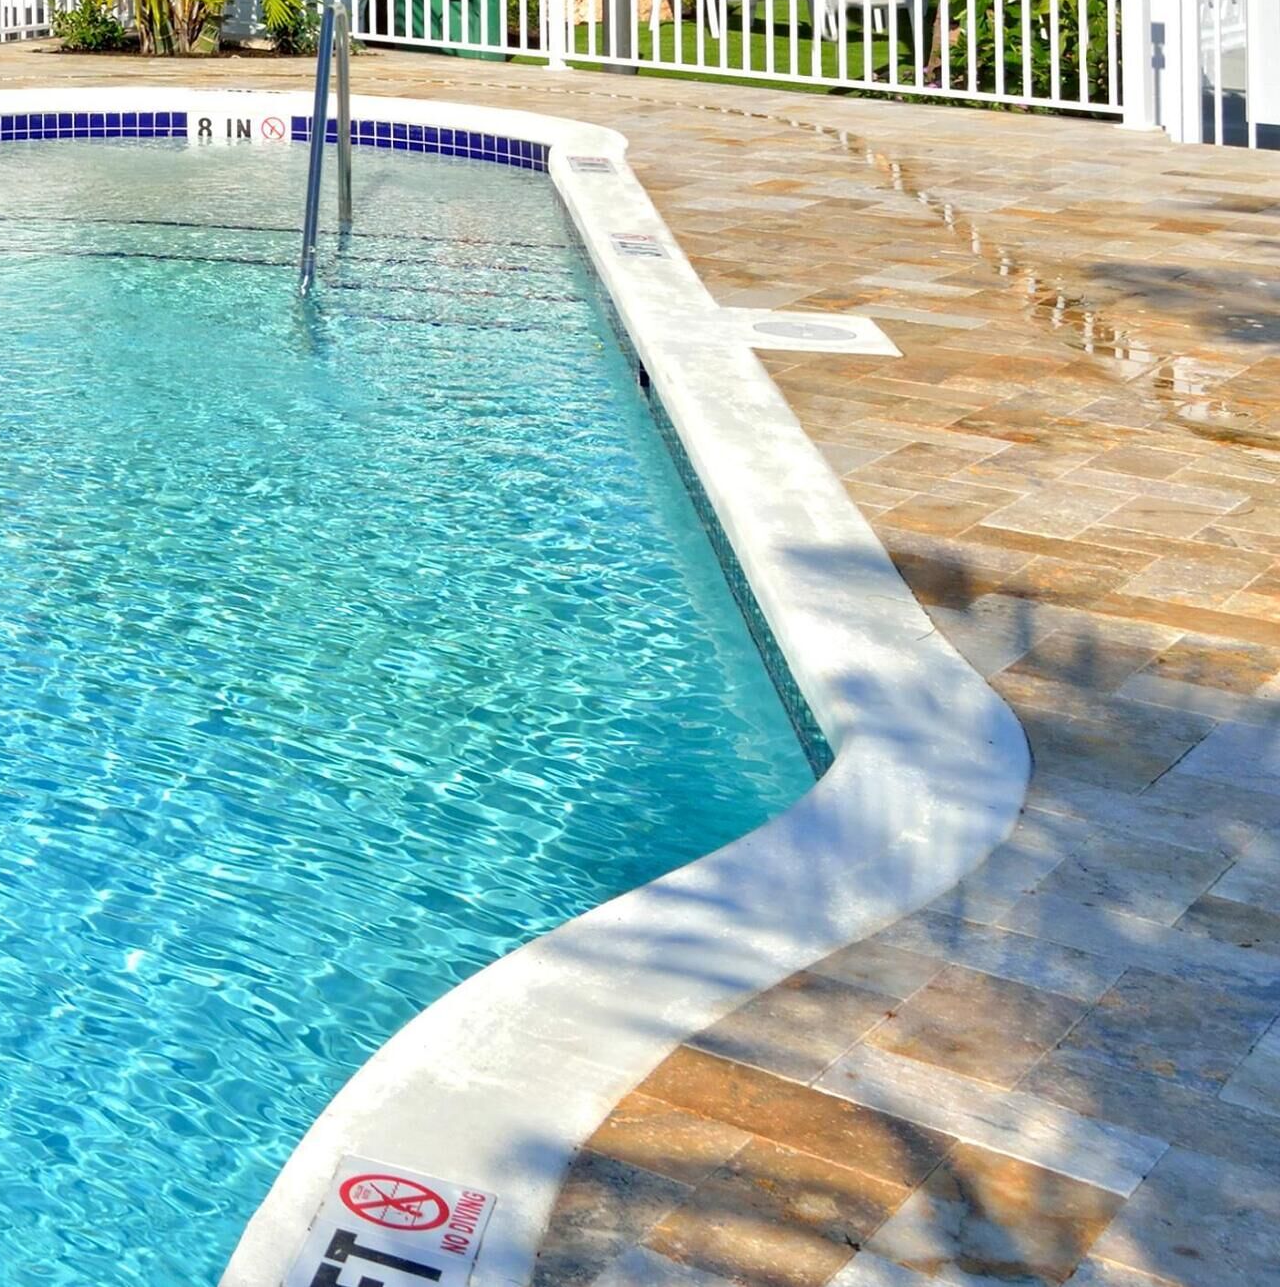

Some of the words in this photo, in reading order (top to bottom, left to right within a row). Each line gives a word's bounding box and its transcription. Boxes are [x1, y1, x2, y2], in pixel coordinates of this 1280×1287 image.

[198, 117, 213, 138] 8
[226, 118, 252, 139] IN
[451, 1191, 487, 1234] DIVING
[441, 1233, 471, 1255] NO
